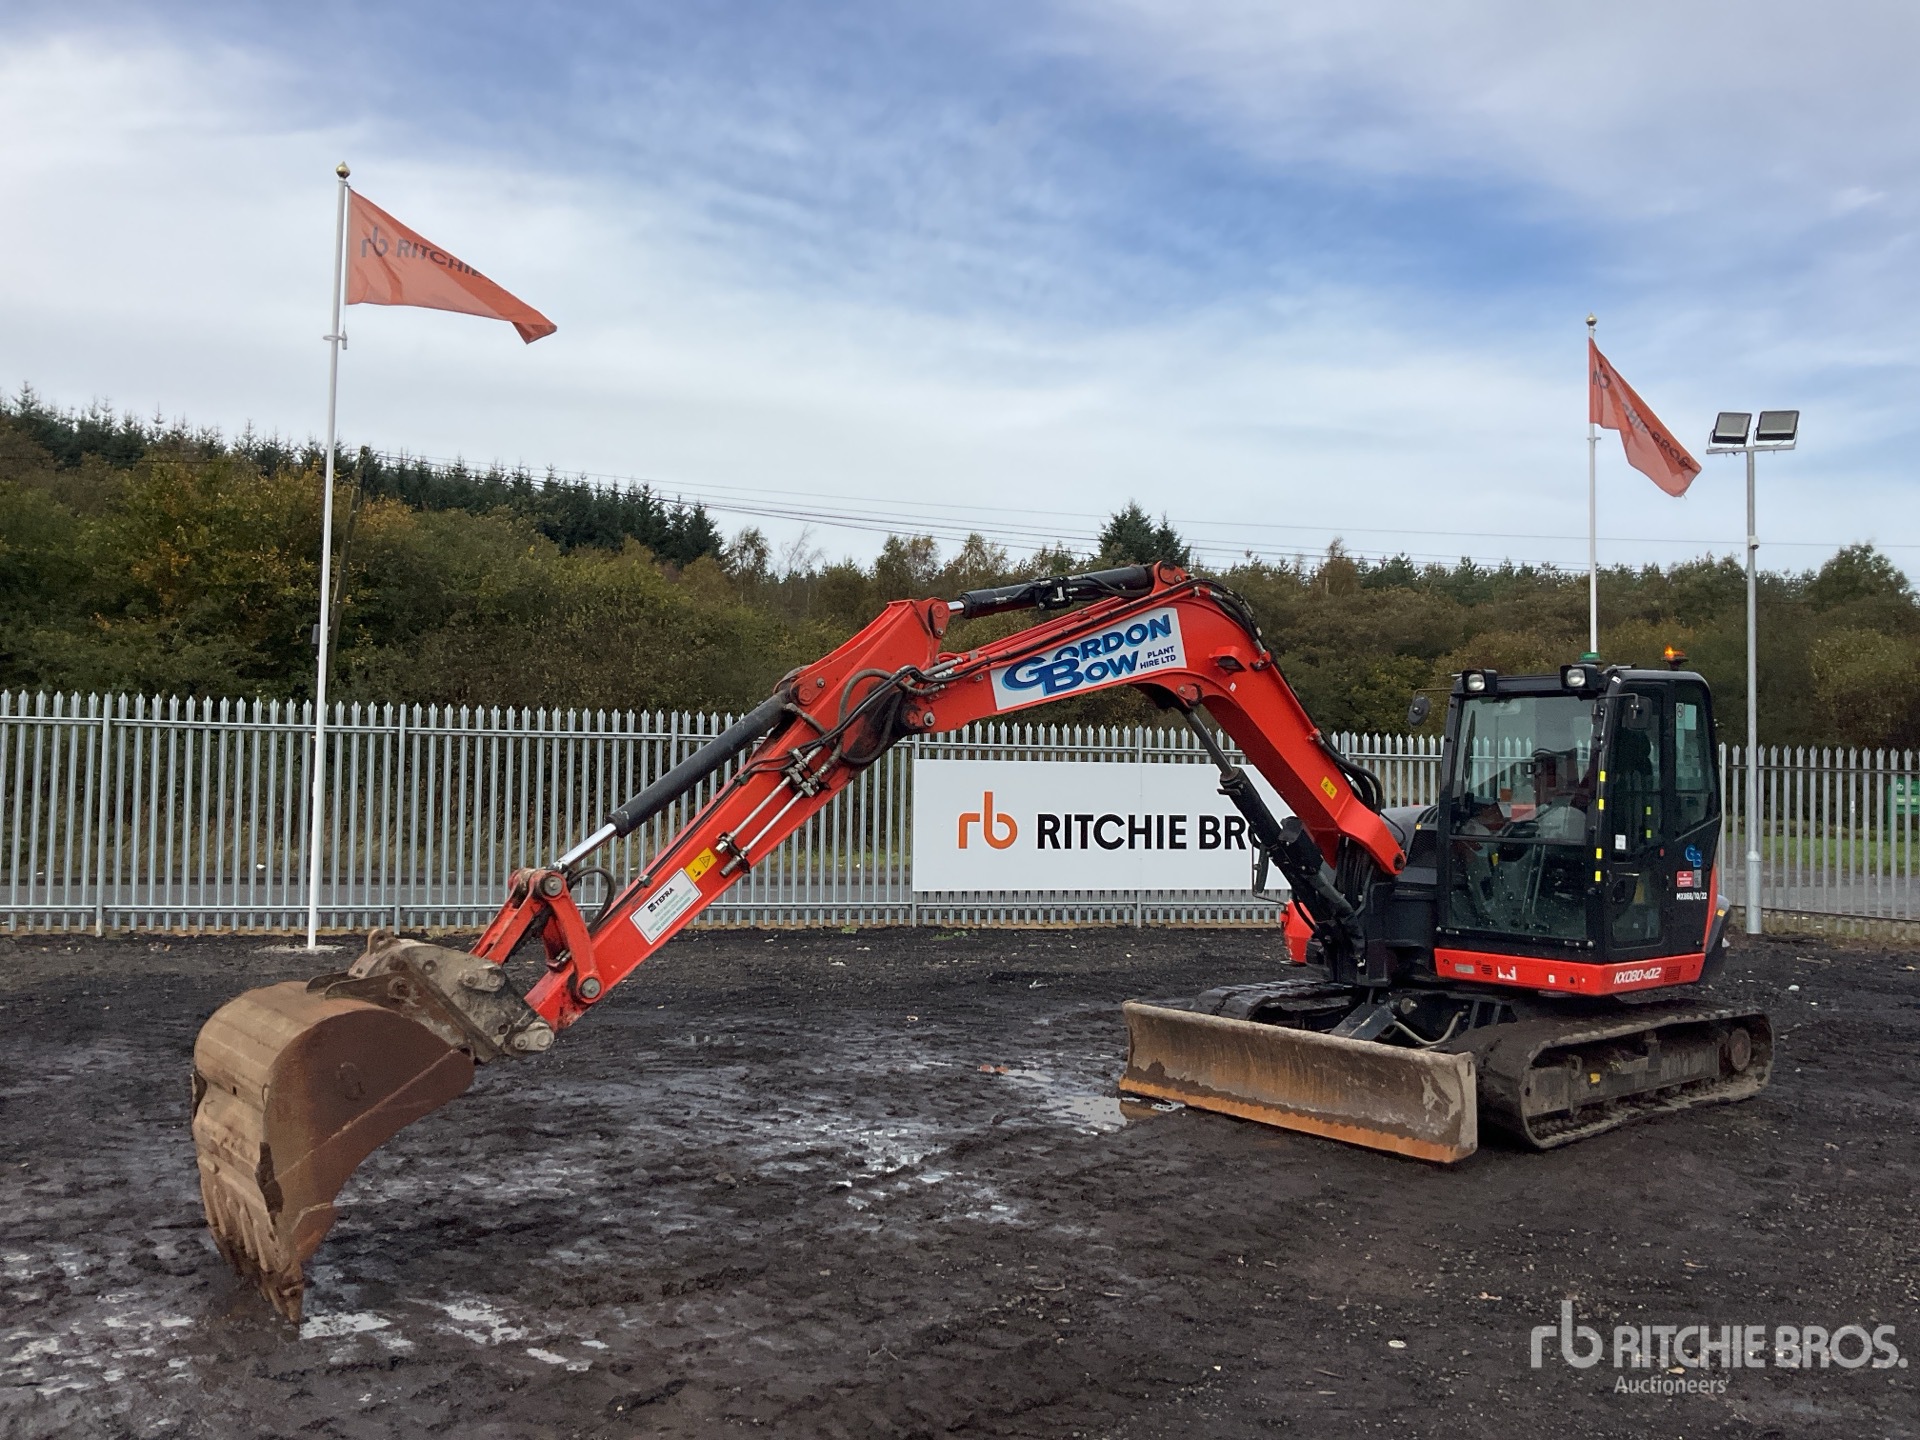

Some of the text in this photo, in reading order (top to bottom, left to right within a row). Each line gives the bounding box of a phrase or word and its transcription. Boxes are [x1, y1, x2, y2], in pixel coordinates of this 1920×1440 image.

[1002, 614, 1172, 691] GORDON
[1042, 650, 1139, 697] BOW
[1140, 654, 1177, 669] HIRE LTD
[1147, 646, 1175, 659] PLANT
[958, 791, 1261, 850] rb RITCHIE BR
